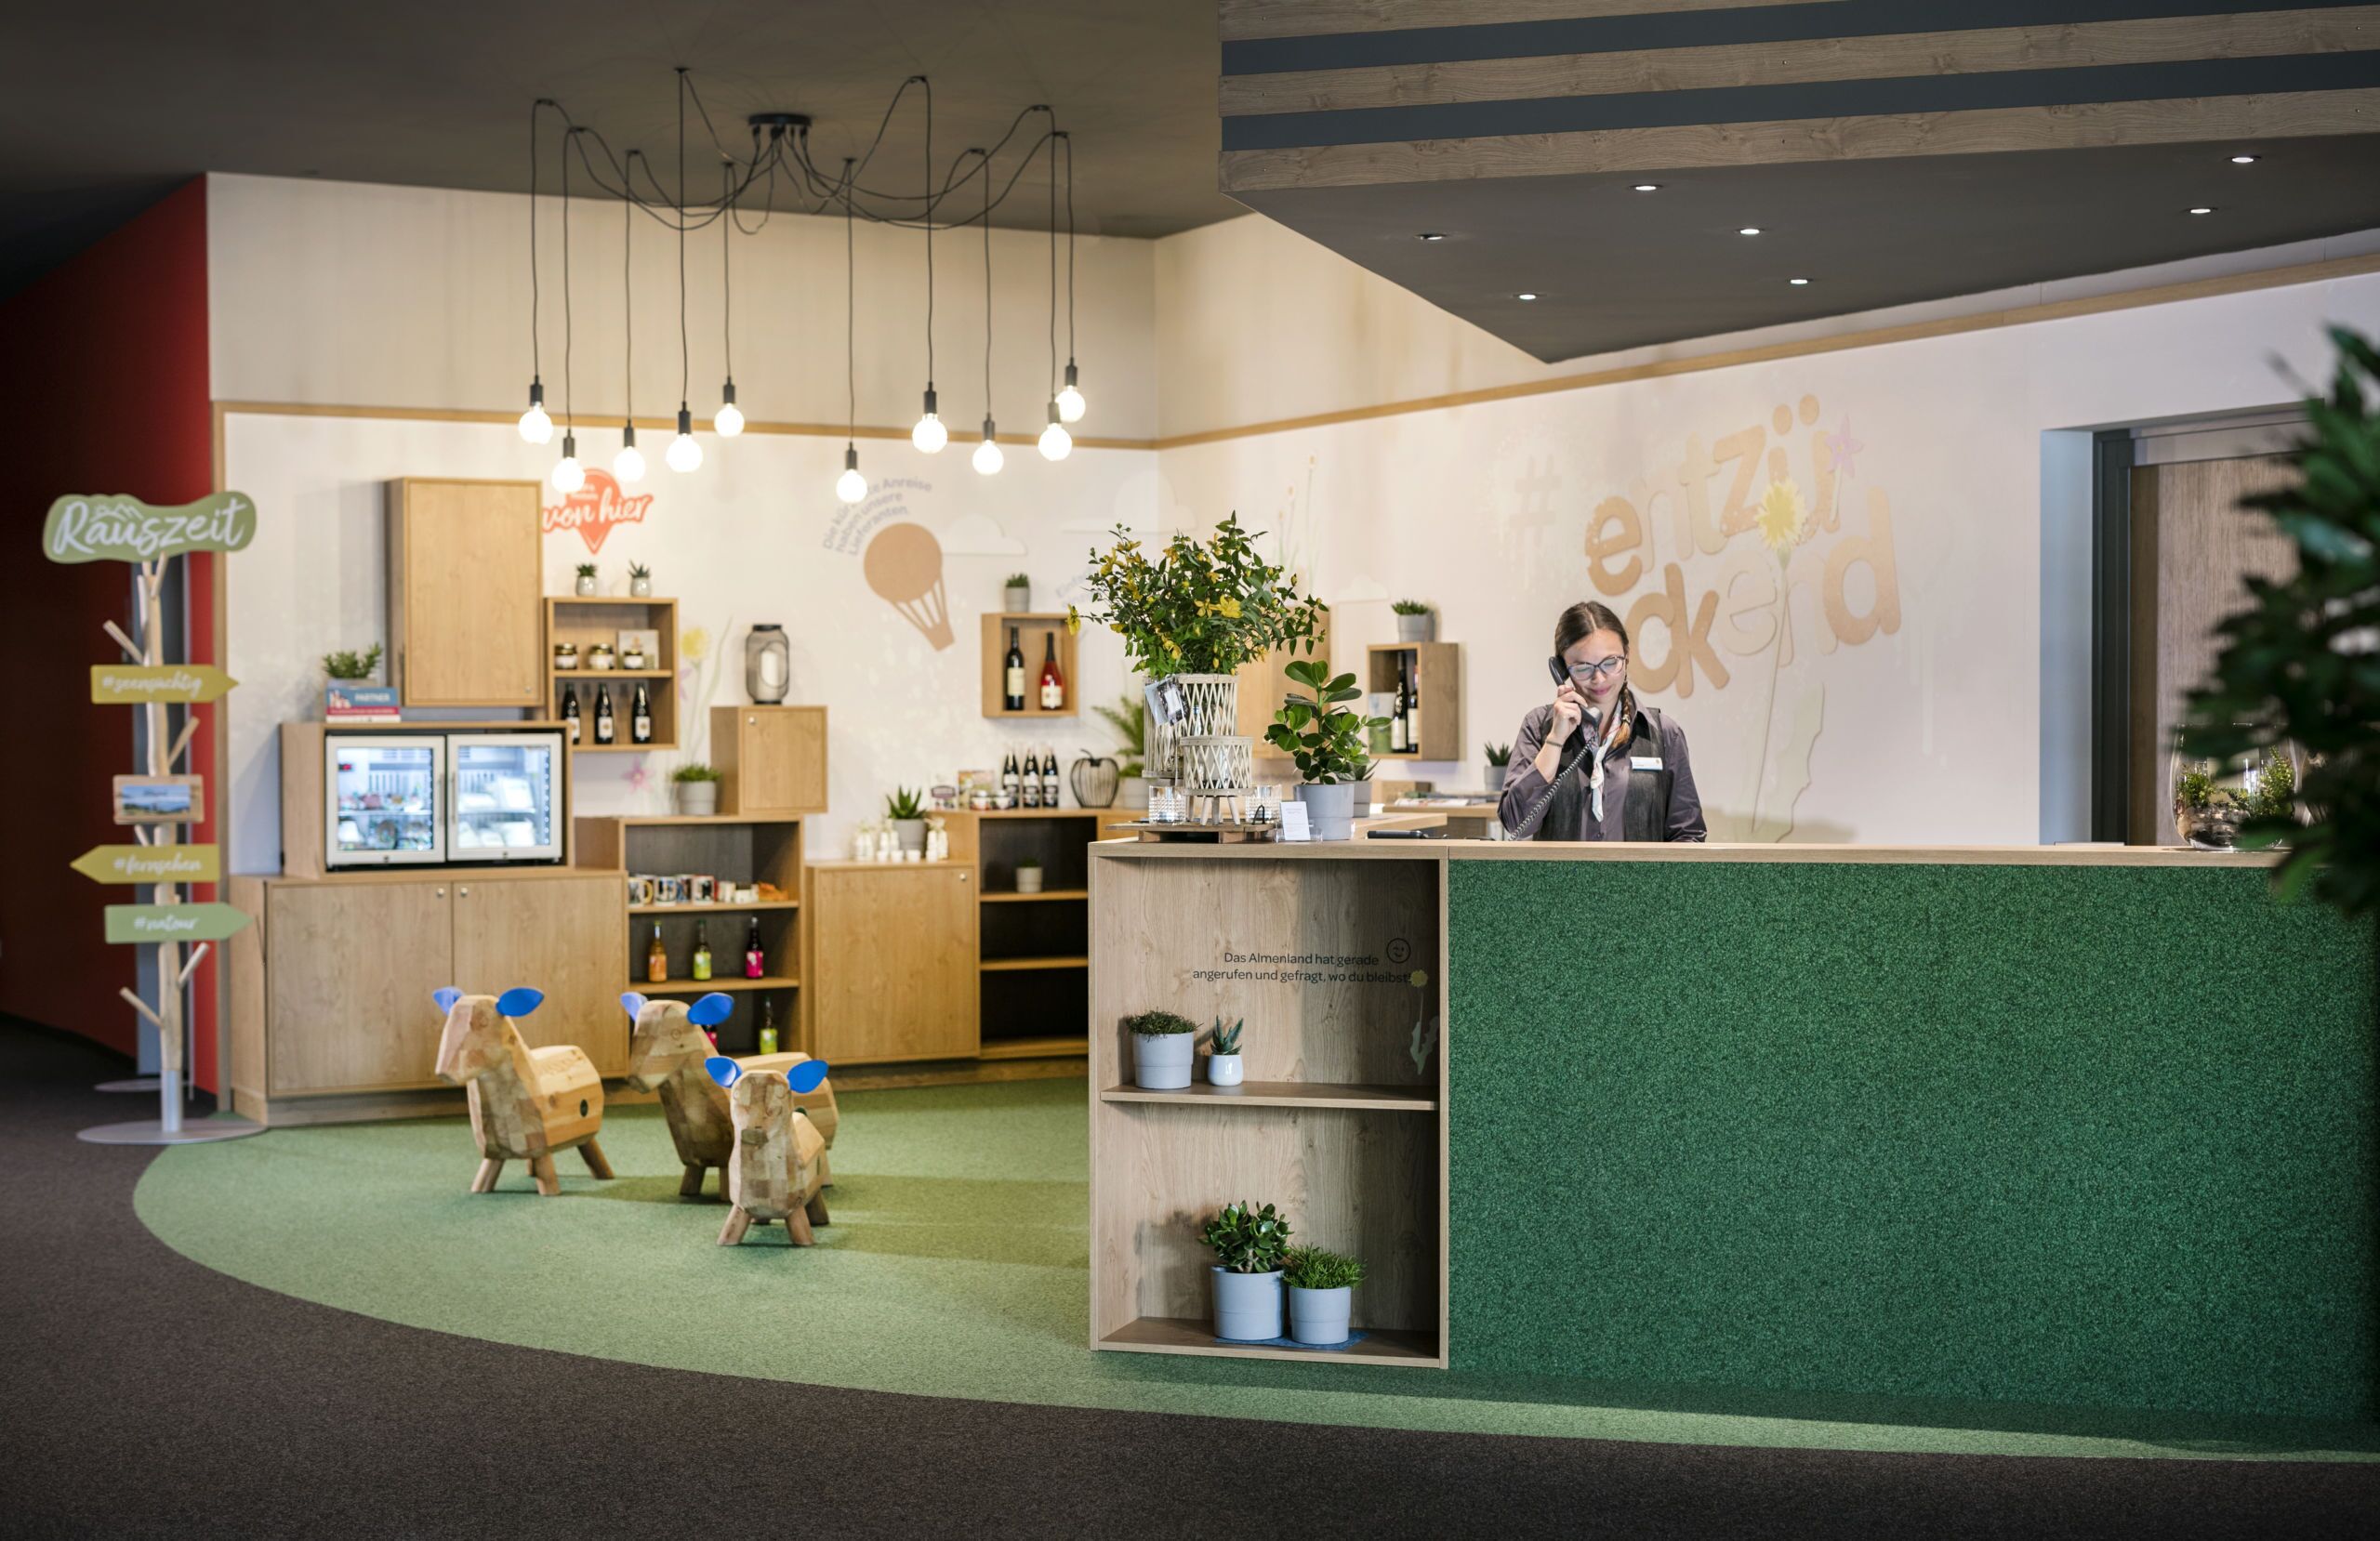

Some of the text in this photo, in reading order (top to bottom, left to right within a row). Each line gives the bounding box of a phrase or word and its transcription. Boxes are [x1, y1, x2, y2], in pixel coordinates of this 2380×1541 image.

[883, 478, 932, 492] Anreise
[542, 485, 652, 530] von hier
[836, 492, 902, 553] haben unsere
[52, 497, 248, 556] Rauszeit
[1224, 953, 1380, 968] Das Almenland hat gerade
[1193, 969, 1253, 981] angerufen
[1255, 970, 1278, 981] und
[1280, 970, 1326, 983] gefragt,
[1329, 974, 1346, 982] wo
[1348, 972, 1364, 982] du
